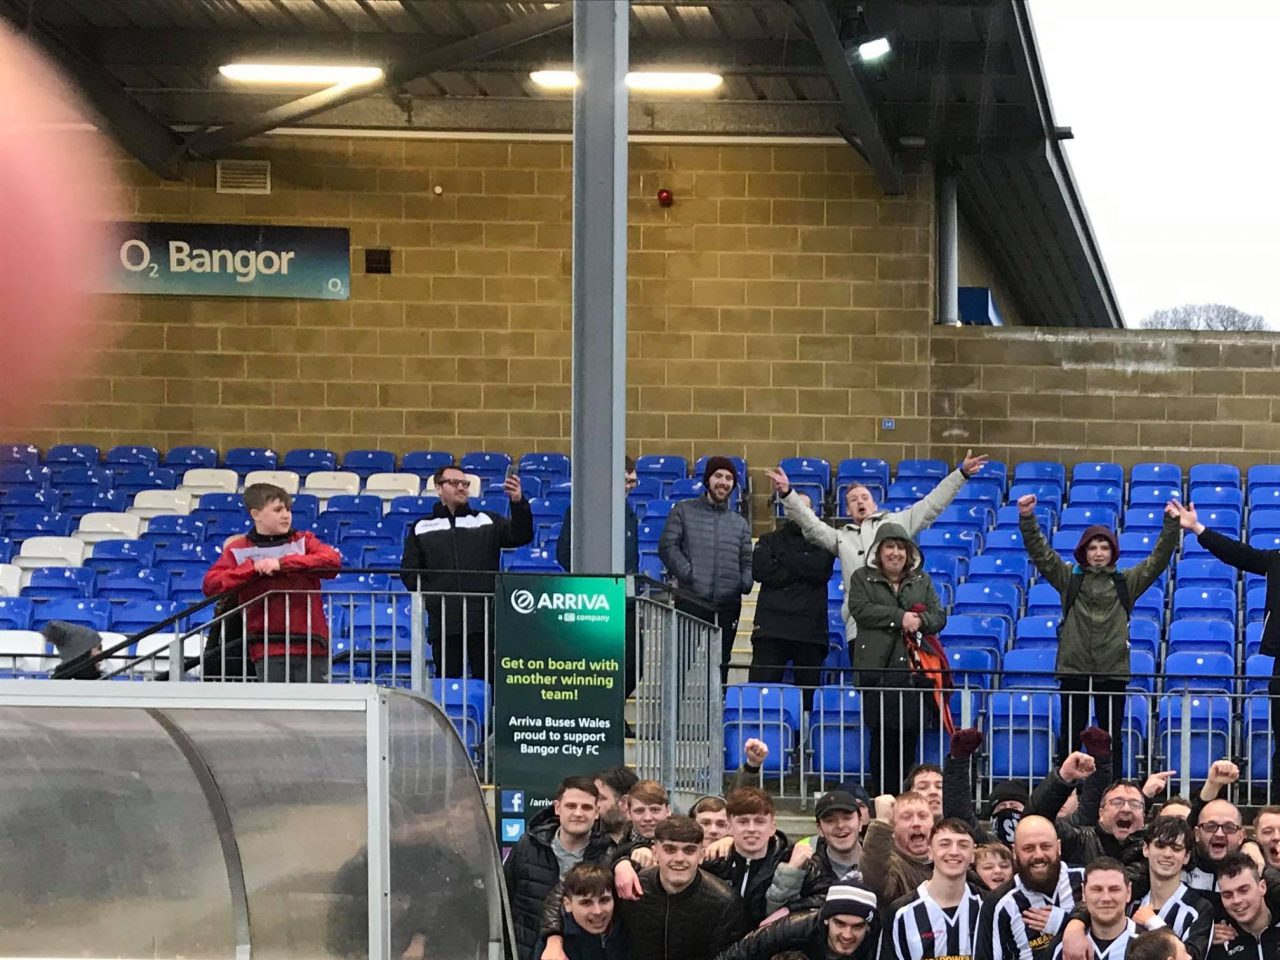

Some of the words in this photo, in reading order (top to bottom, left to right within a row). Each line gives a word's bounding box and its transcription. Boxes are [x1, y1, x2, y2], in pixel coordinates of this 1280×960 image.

[120, 239, 159, 277] O2
[168, 240, 295, 282] Bangor
[537, 592, 610, 610] ARRIVA
[576, 614, 610, 623] company
[501, 657, 524, 669] Get
[527, 659, 544, 669] on
[548, 657, 586, 670] board
[589, 659, 619, 671] with
[506, 672, 557, 684] another
[560, 673, 614, 688] winning
[541, 689, 578, 700] team!
[509, 716, 542, 726] Arriva
[545, 717, 576, 727] Buses
[578, 718, 610, 728] Wales
[513, 730, 546, 742] proud
[549, 731, 560, 740] to
[563, 732, 606, 743] support
[520, 744, 559, 756] Bangor
[562, 745, 583, 757] City
[586, 746, 600, 755] FC
